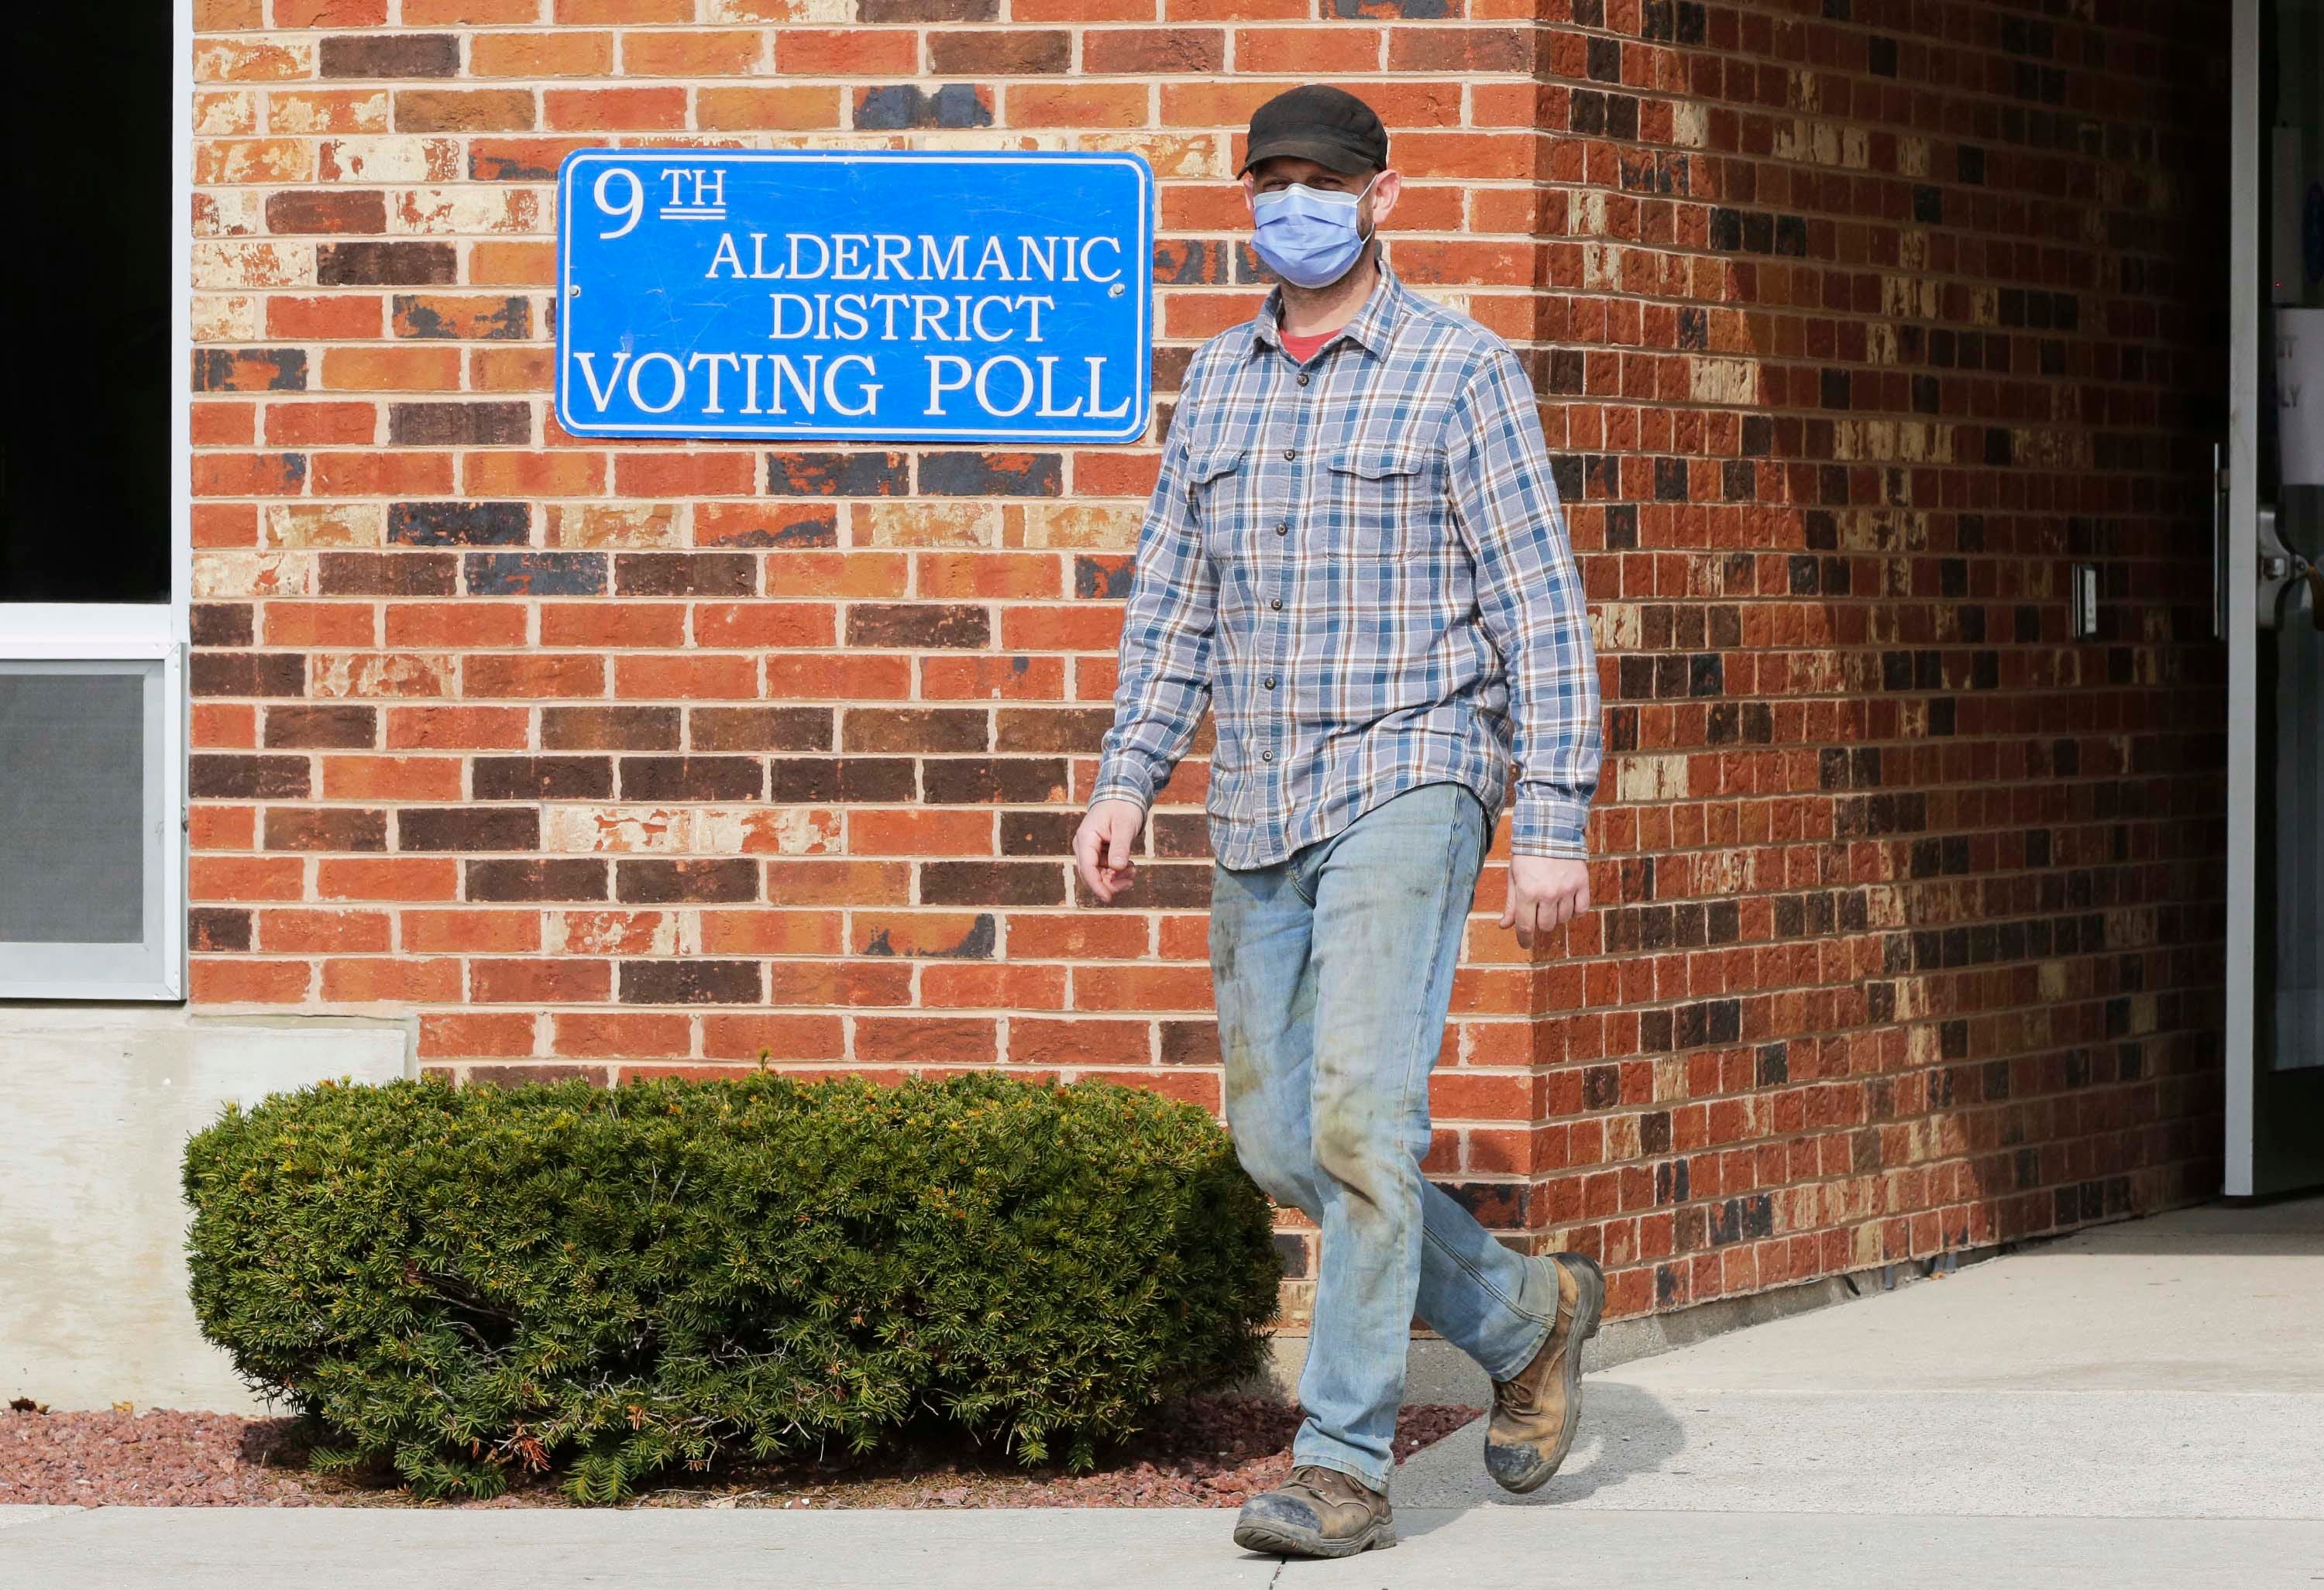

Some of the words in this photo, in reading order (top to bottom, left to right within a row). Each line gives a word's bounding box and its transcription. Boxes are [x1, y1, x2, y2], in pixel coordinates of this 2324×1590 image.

[593, 167, 644, 239] 9
[660, 168, 727, 206] TH
[705, 232, 1122, 283] ALDERMANIC
[768, 294, 1055, 342] DISTRICT
[573, 352, 884, 416] VOTING
[923, 355, 1131, 418] POLL
